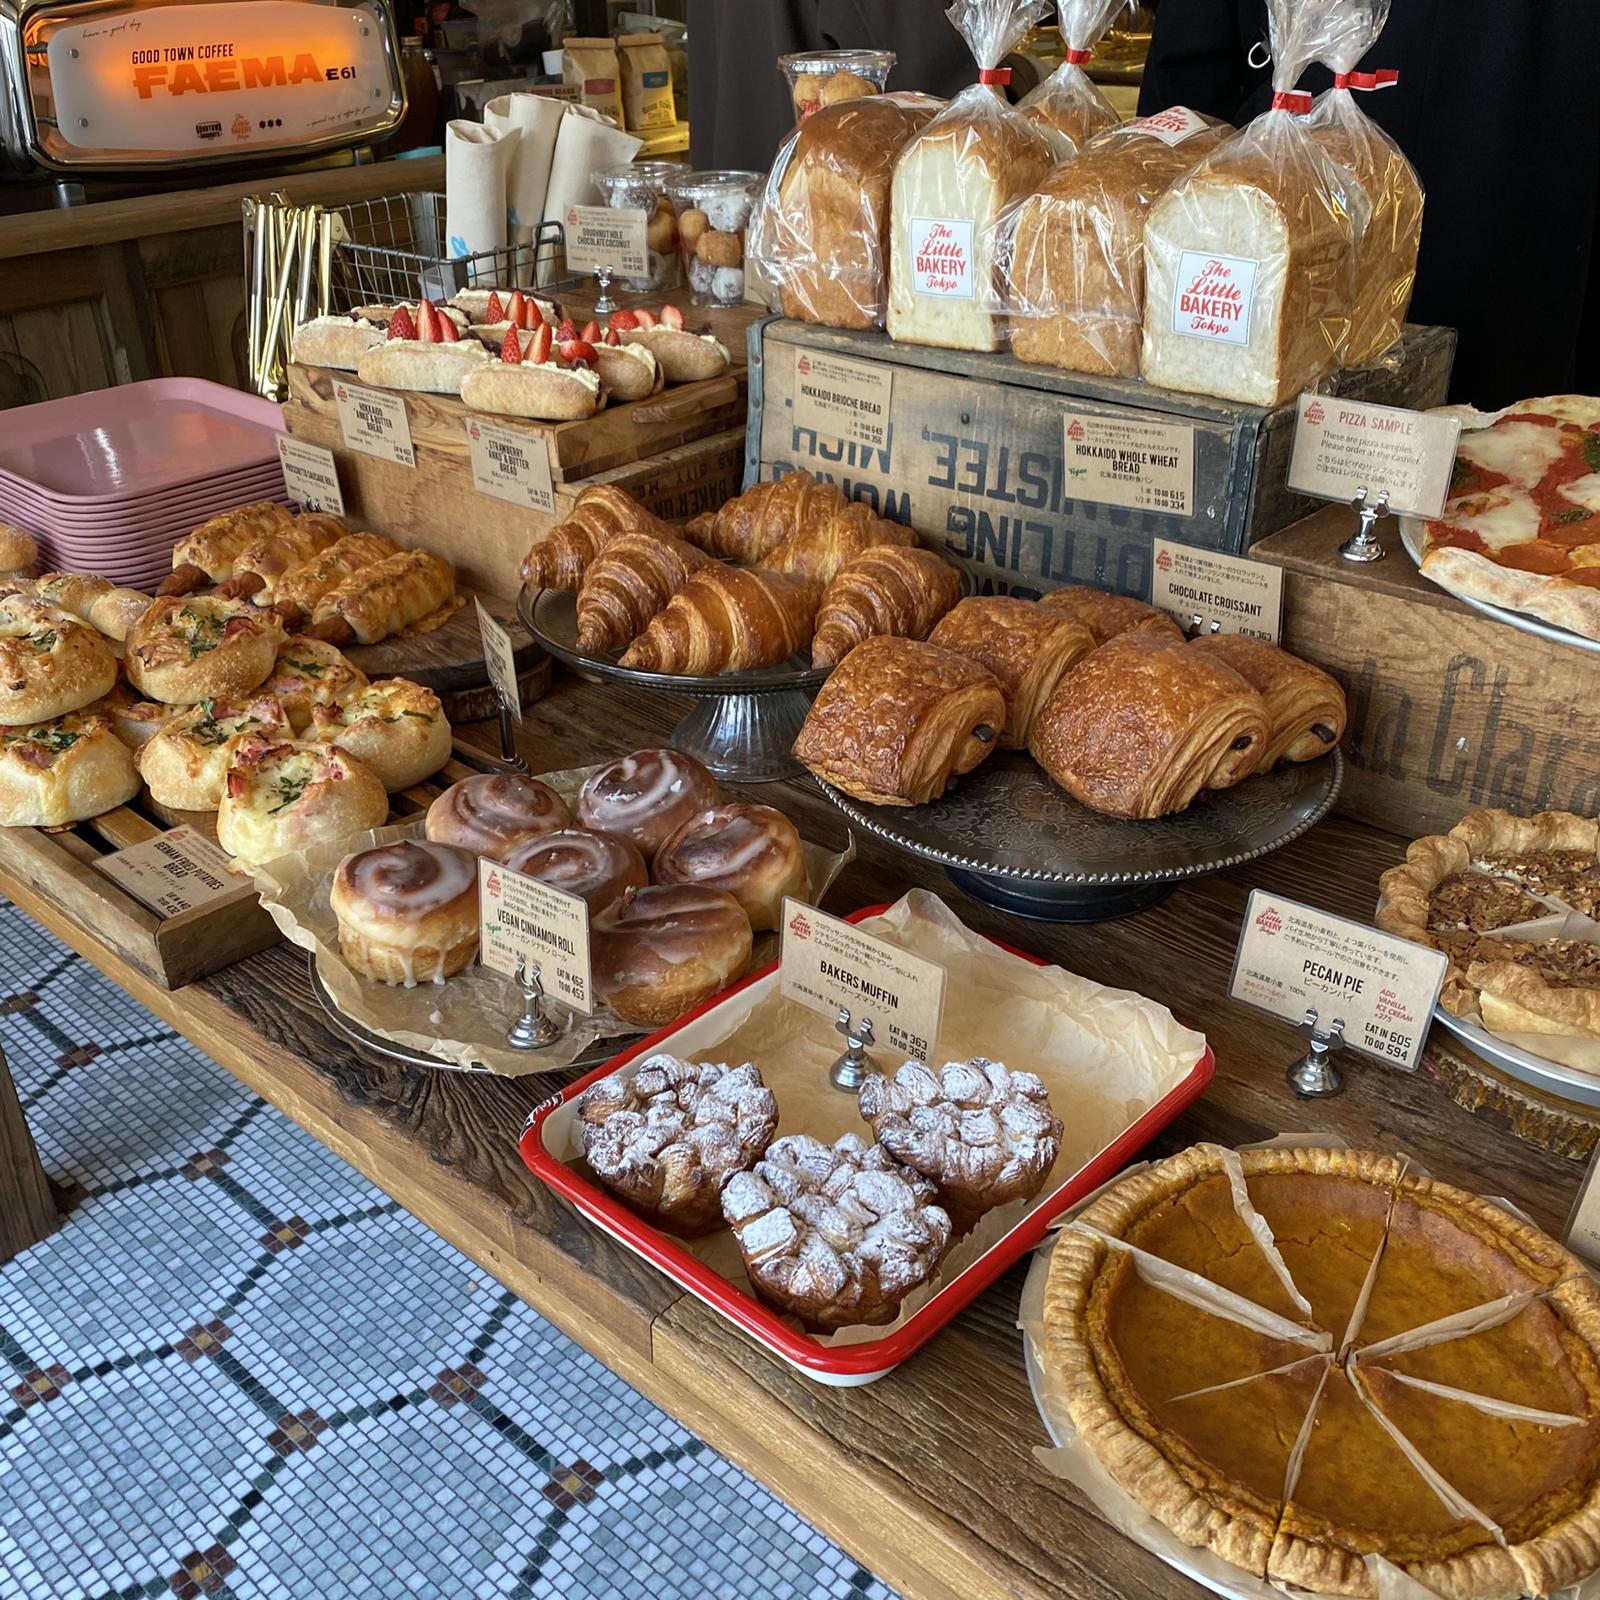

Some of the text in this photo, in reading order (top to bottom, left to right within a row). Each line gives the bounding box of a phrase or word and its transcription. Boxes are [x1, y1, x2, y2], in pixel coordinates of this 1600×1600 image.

[132, 44, 234, 64] GOOD TOWN COFFEE
[133, 54, 324, 99] FAEMA
[326, 66, 356, 81] E61
[929, 223, 953, 238] The
[577, 236, 630, 248] CHOCOLATE COCONUT
[919, 239, 963, 257] Little
[916, 256, 966, 276] BAKERY
[1202, 260, 1231, 277] The
[926, 275, 957, 292] Tokyo
[1186, 275, 1241, 300] Little
[1180, 294, 1243, 320] BAKERY
[1190, 316, 1229, 335] Tokyo
[358, 401, 383, 416] HOKKAIDO
[801, 384, 881, 415] HOKKAIDO BRIOCHE BREAD
[1338, 411, 1412, 434] PIZZA SAMPLE
[488, 439, 523, 458] STRAWBERRY
[1322, 430, 1344, 441] These
[1359, 437, 1379, 448] pizza
[1076, 444, 1177, 468] HOKKAIDO WHOLE WHEAT
[1320, 439, 1344, 450] Please
[1345, 444, 1365, 454] order
[1376, 451, 1390, 459] the
[499, 462, 517, 475] BREAD
[508, 455, 529, 470] BUTTER
[1112, 460, 1139, 473] BREAD
[1169, 490, 1184, 499] 615
[1170, 500, 1184, 510] 334
[945, 504, 1149, 600] OTTLING
[1168, 582, 1261, 617] CHOCOLATE CROISSANT
[1178, 598, 1249, 623] チョコレートクロワッサン
[1239, 626, 1271, 642] EAT IN 363
[152, 840, 184, 860] GERMAN
[174, 856, 198, 871] FRIED
[190, 867, 224, 890] POTATOES
[162, 862, 189, 878] BREAD
[1259, 910, 1282, 924] Little
[1266, 905, 1278, 915] The
[497, 908, 574, 955] VEGAN CINNAMON ROLL
[789, 921, 810, 936] BAKERY
[793, 917, 810, 929] Little
[1255, 916, 1282, 932] BAKERY
[1257, 925, 1275, 937] Tokyo
[556, 967, 583, 988] EAT IN 462
[820, 959, 898, 1008] BAKERS MUFFIN
[1302, 959, 1364, 994] PECAN PIE
[558, 980, 564, 990] TO
[571, 985, 583, 1001] 453
[826, 977, 890, 1015] ベーカーズマフィン
[1288, 985, 1306, 997] 100%
[1302, 976, 1354, 1003] ピーカンパイ
[1379, 988, 1396, 999] ADD
[1375, 1003, 1413, 1023] ICE CREAM
[1378, 996, 1407, 1011] VANILLA
[1374, 1010, 1392, 1022] +275
[889, 1024, 927, 1050] EAT IN 363
[1364, 1021, 1412, 1049] EAT IN 605
[890, 1036, 926, 1061] TO GO 356
[1363, 1035, 1408, 1061] TO GO 594
